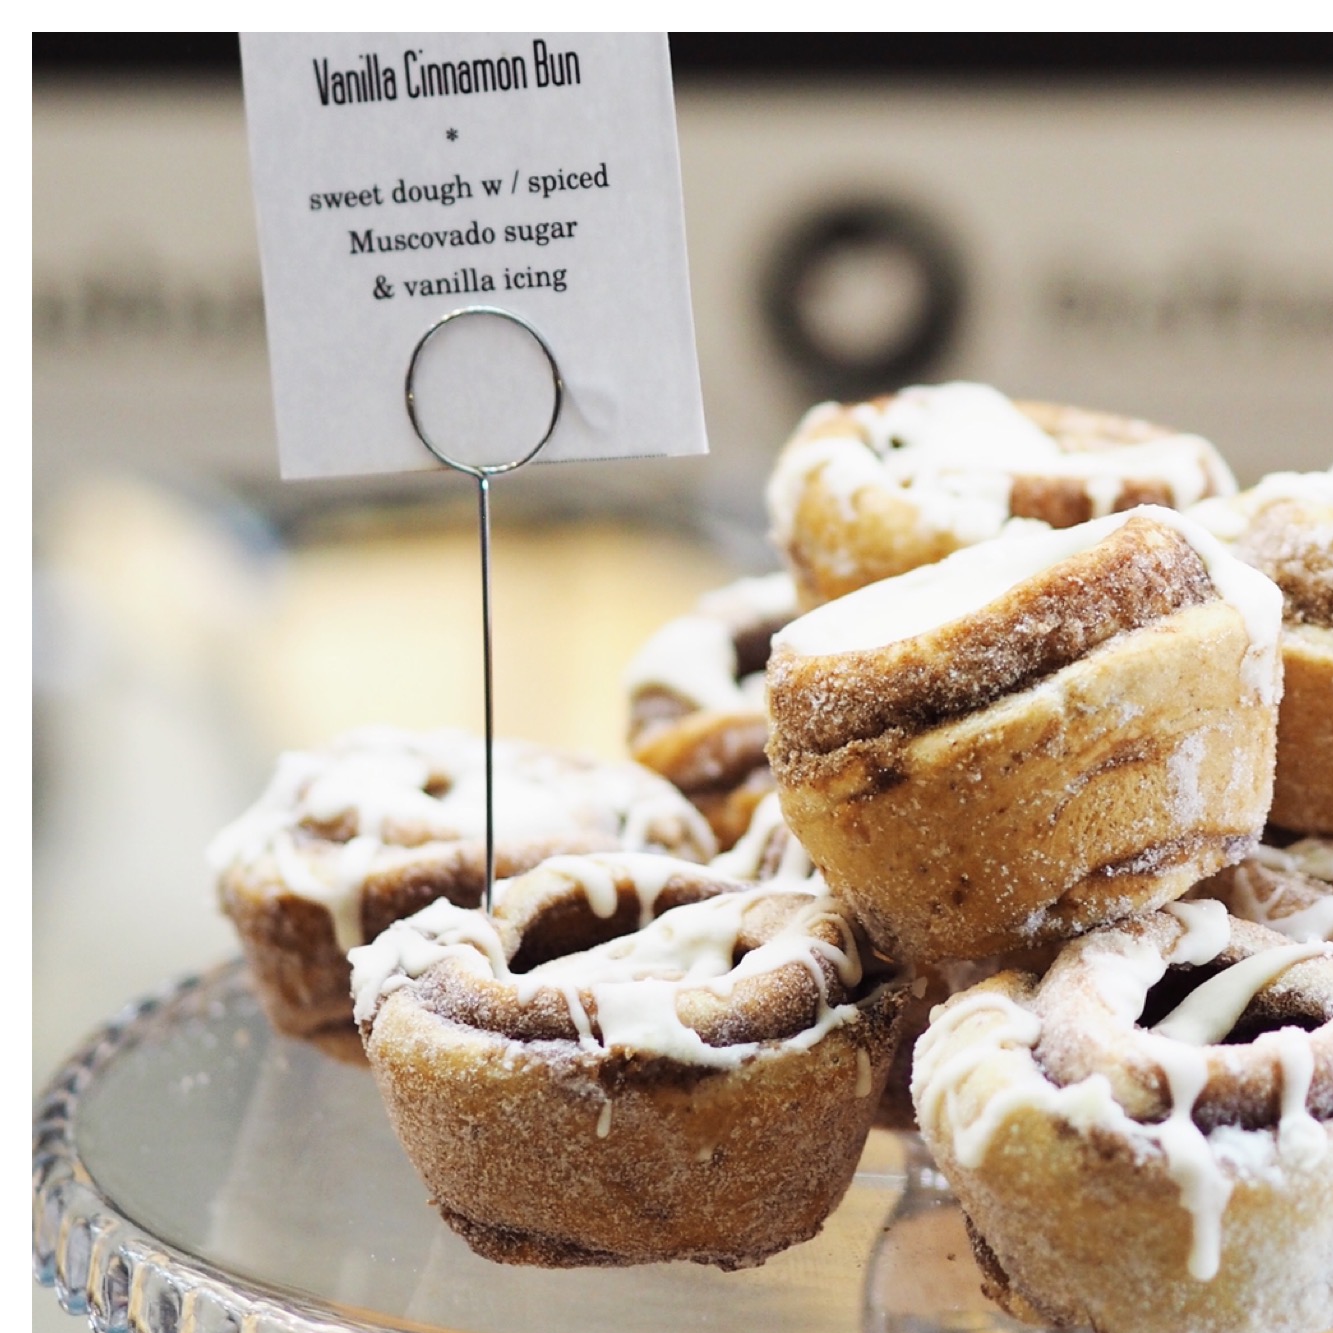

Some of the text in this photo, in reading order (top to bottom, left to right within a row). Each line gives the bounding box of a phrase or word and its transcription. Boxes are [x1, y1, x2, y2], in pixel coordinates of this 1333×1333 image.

[312, 38, 582, 107] Vanilla Cinnamon Bun
[308, 184, 385, 212] sweet
[391, 173, 474, 208] dough
[527, 163, 610, 198] spiced
[348, 220, 579, 255] Muscovado sugar
[372, 265, 569, 301] & vanilla icing
